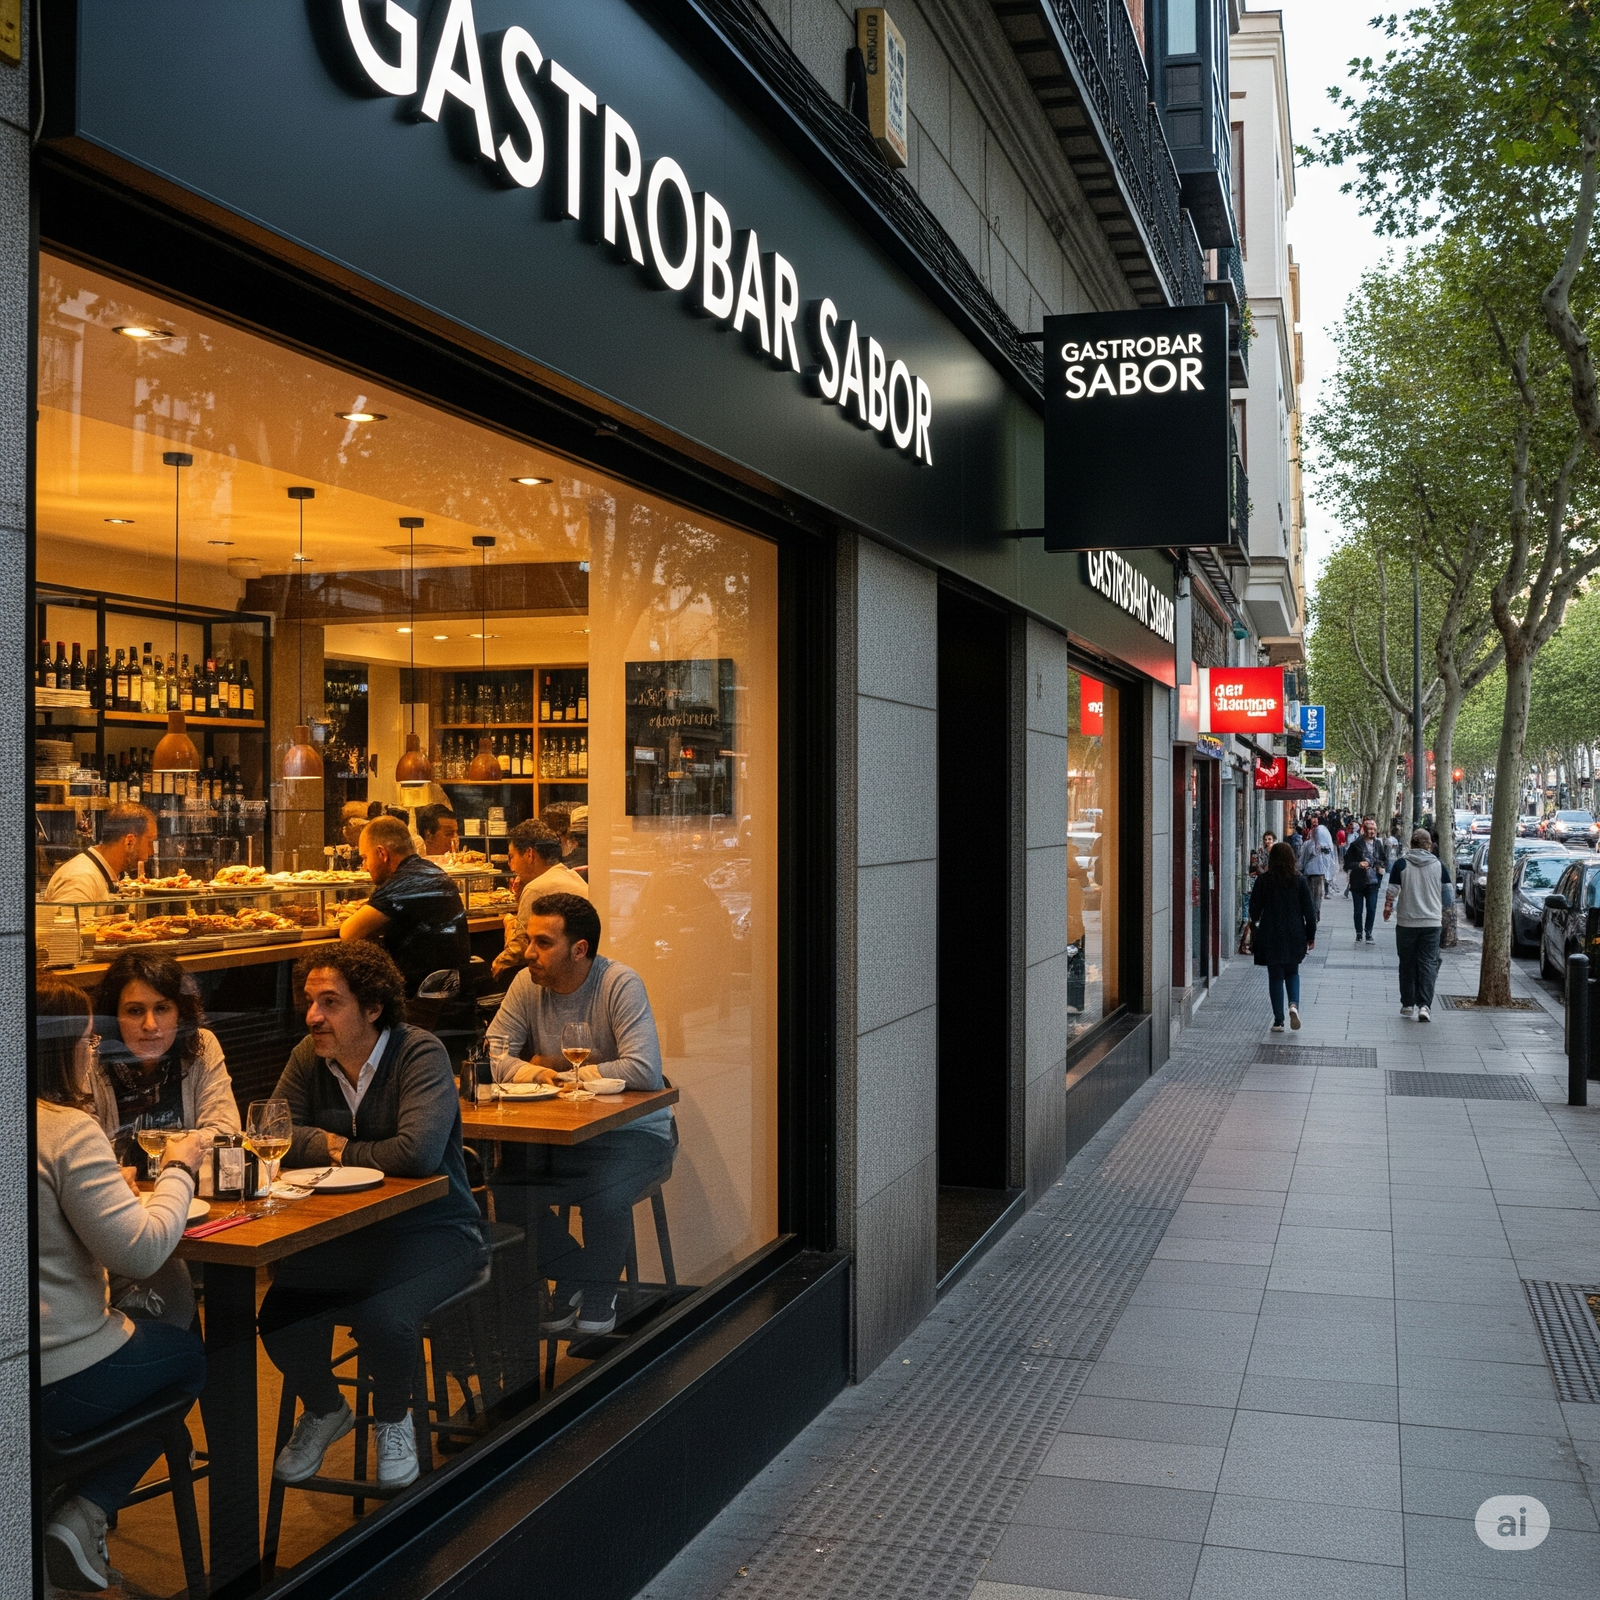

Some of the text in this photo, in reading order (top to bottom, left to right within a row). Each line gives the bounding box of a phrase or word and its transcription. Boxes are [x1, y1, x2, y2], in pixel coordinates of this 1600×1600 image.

[340, 0, 934, 467] GASTROBAR SABOR
[1061, 333, 1204, 363] GASTROBAR
[1065, 357, 1206, 399] SABOR
